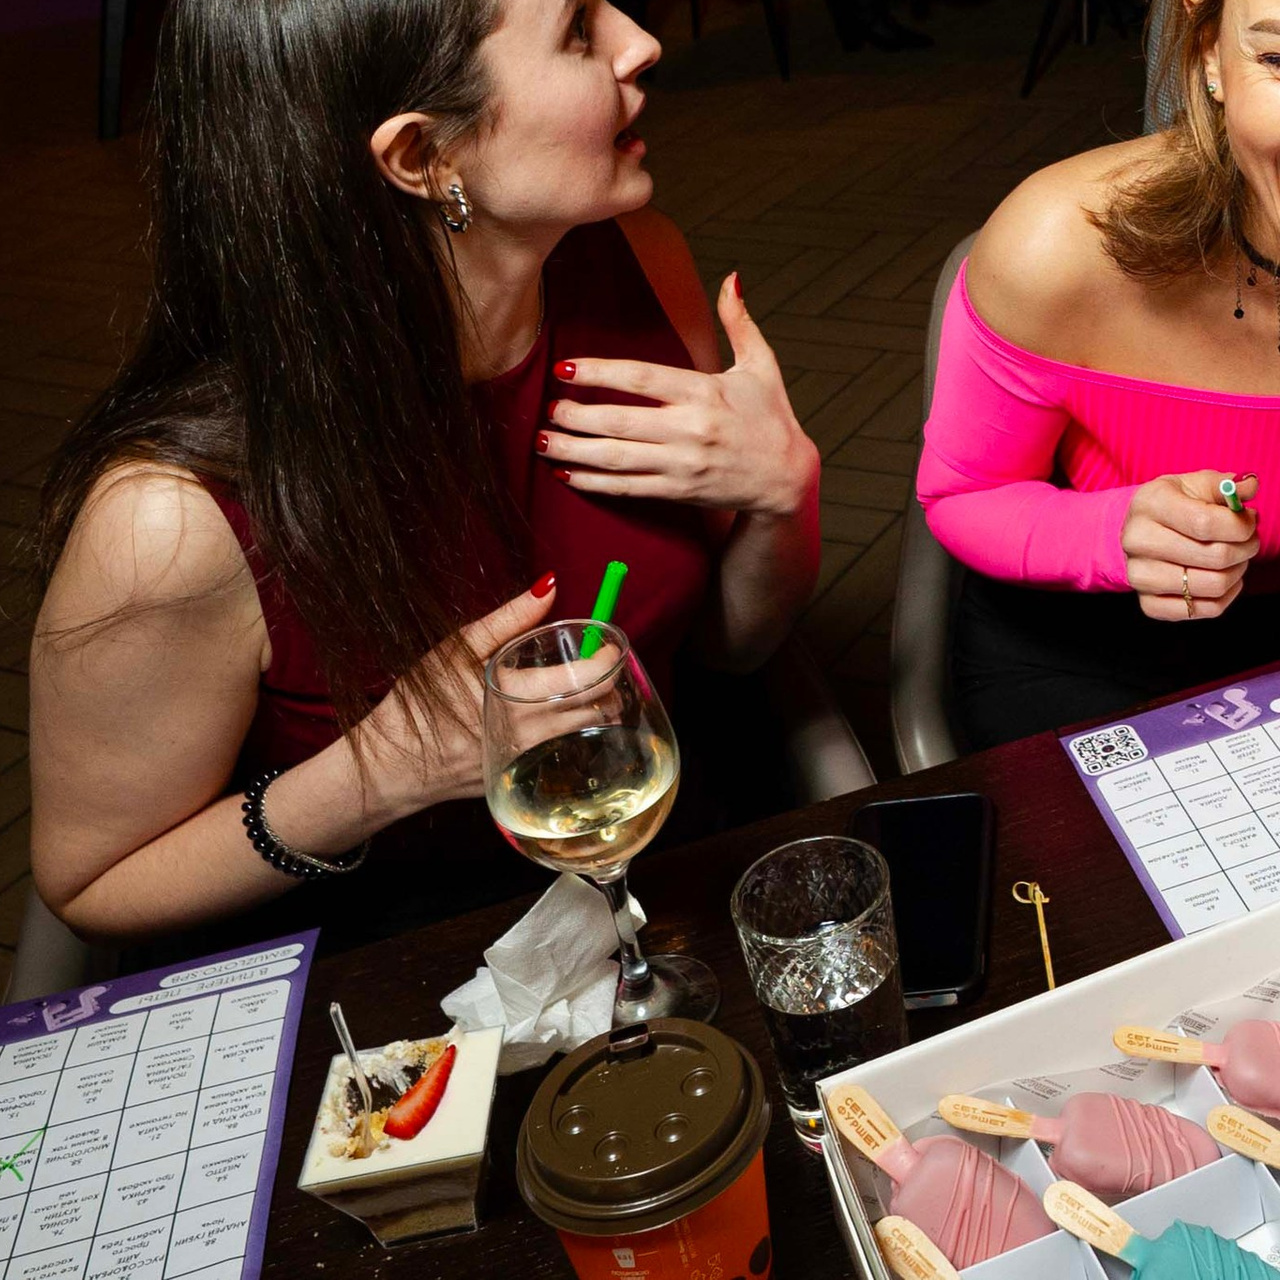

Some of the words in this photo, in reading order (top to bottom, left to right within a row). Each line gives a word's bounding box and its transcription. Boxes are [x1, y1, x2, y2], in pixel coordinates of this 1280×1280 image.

[169, 947, 293, 984] @MUZLOTO.SPB
[258, 966, 268, 976] В
[195, 970, 255, 991] ПИТЕРЕ
[1126, 1039, 1180, 1053] ФУРШЕТ
[1127, 1033, 1151, 1042] СЕТ
[845, 1096, 866, 1120] СЕТ
[953, 1104, 977, 1115] СЕТ
[836, 1105, 880, 1151] ФУРШЕТ
[952, 1111, 1007, 1127] ФУРШЕТ
[1220, 1114, 1245, 1131] СЕТ
[1216, 1122, 1269, 1153] ФУРШЕТ
[1059, 1192, 1085, 1211] СЕТ
[891, 1228, 915, 1250] СЕТ
